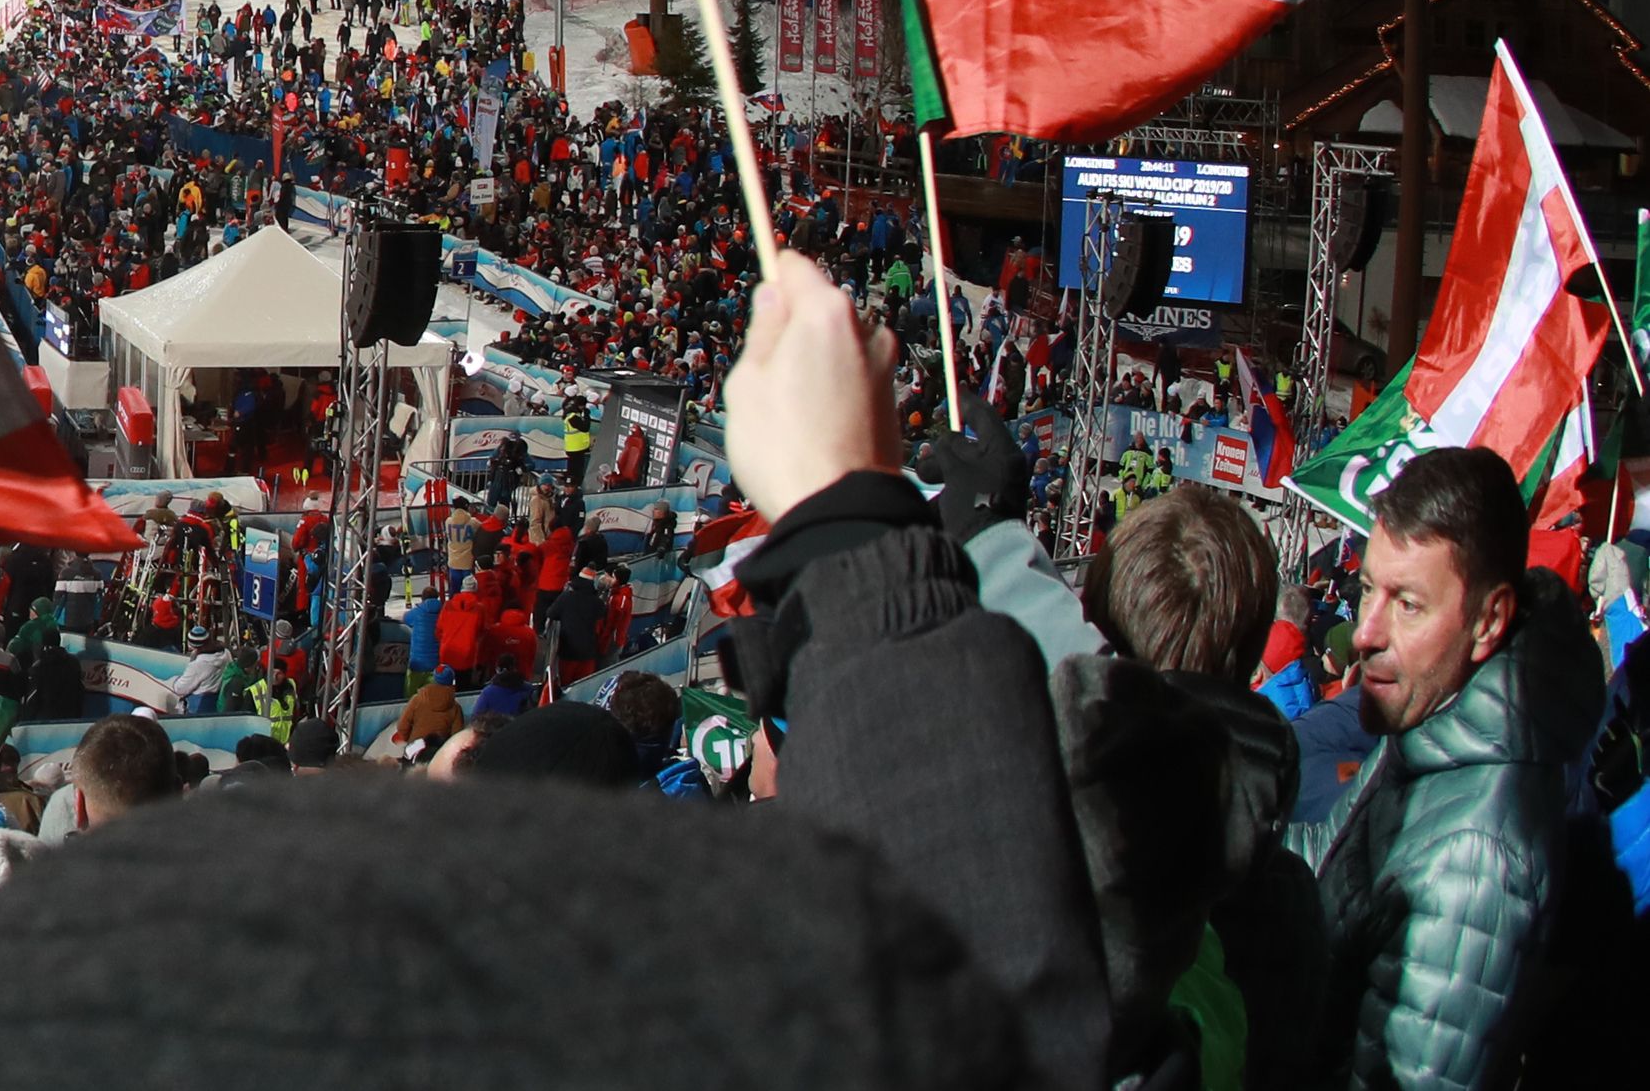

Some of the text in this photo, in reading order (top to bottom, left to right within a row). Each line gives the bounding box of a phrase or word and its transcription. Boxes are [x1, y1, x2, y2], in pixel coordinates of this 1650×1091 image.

[1065, 157, 1116, 170] LONGINES
[1197, 164, 1249, 177] LONGINES
[1077, 172, 1233, 195] AUDI FIS SKI WORLD CUP 2019/20
[1185, 192, 1207, 206] RUN
[1207, 194, 1216, 207] 2
[458, 262, 464, 275] 2
[1131, 411, 1204, 439] Die Kroe
[1216, 441, 1246, 460] Kronen
[1215, 457, 1243, 479] Zeitung
[449, 524, 474, 543] ITA
[252, 579, 260, 607] 3
